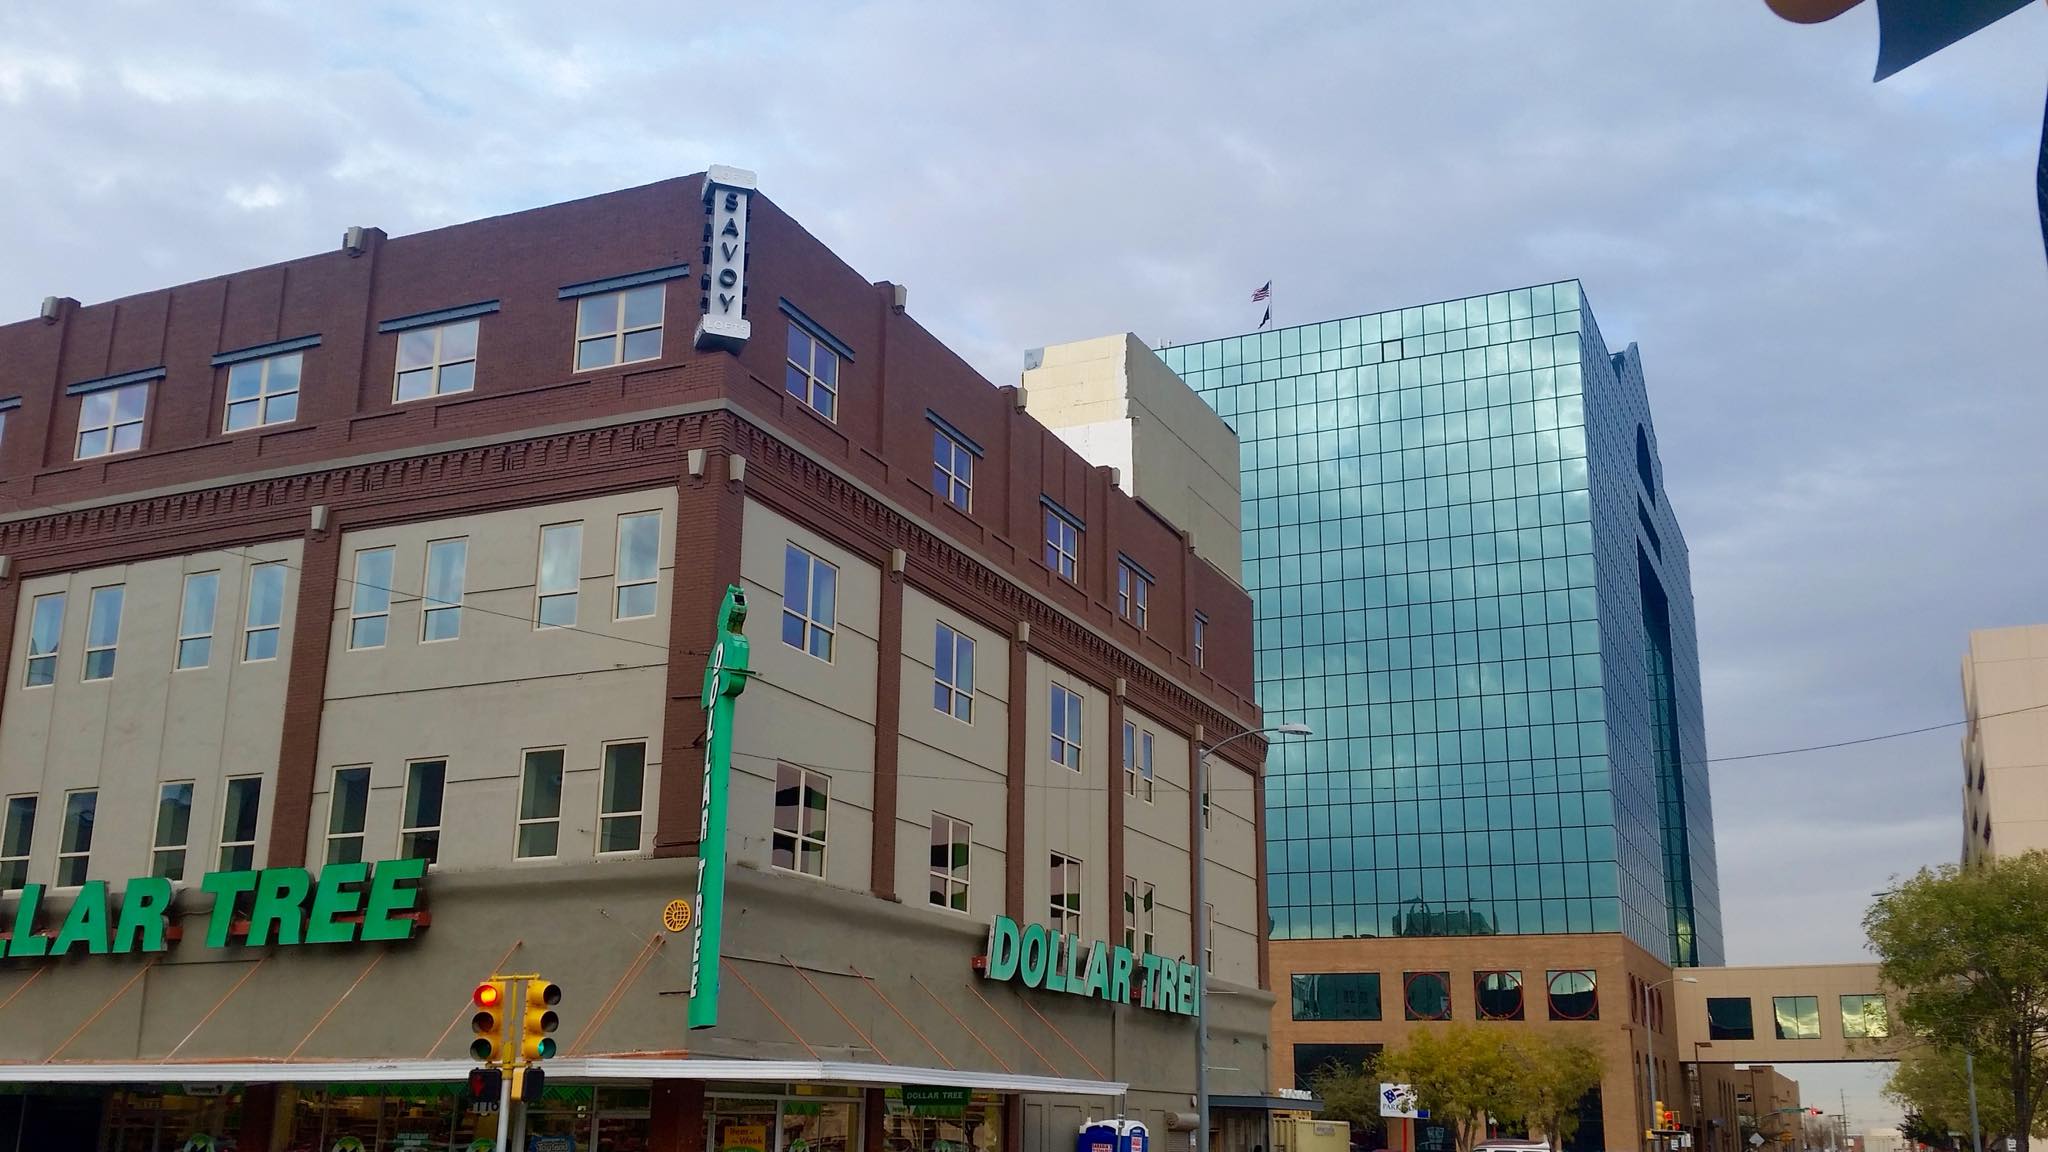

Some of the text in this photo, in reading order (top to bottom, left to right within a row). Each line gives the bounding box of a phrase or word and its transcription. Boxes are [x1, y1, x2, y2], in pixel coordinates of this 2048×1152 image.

[719, 192, 739, 313] SAVOY
[690, 641, 724, 998] DOLLAR TREE
[0, 858, 426, 958] LAR TREE
[988, 914, 1133, 1004] DOLLAR
[906, 1091, 963, 1100] DOLLAR TREE
